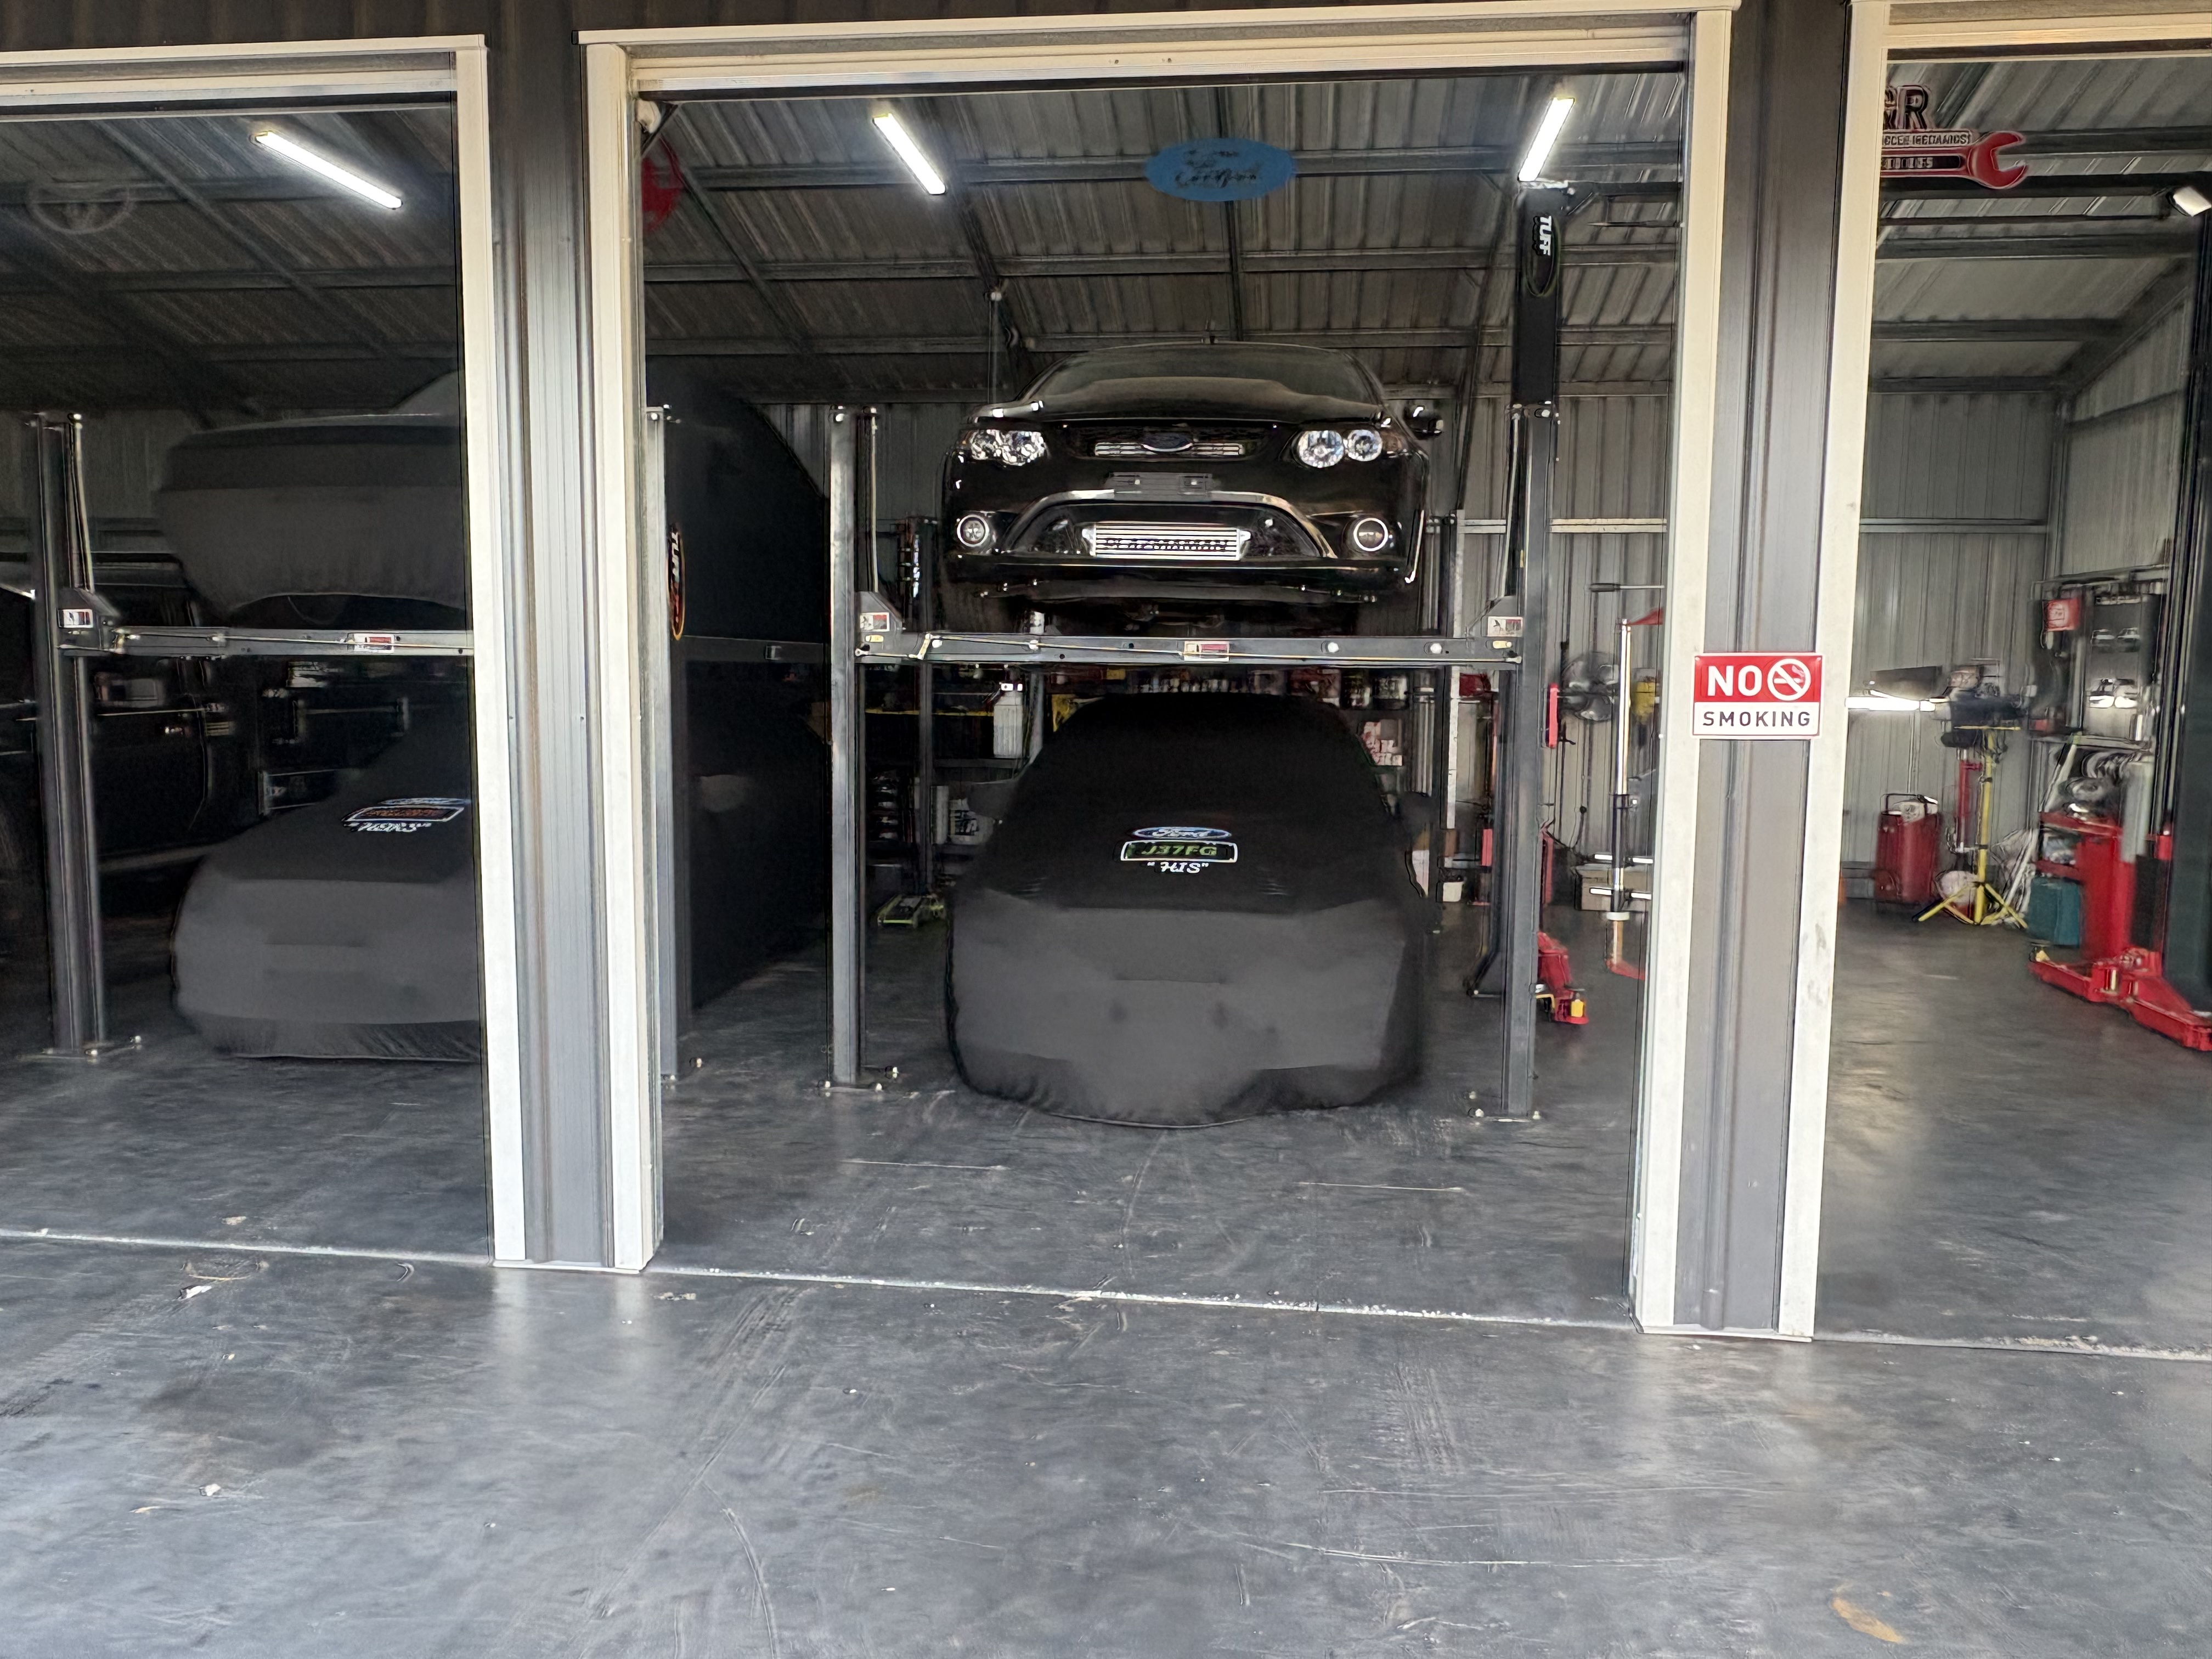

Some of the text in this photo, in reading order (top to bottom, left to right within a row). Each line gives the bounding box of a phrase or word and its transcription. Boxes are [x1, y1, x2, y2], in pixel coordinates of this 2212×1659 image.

[1539, 215, 1552, 256] TUFF
[1707, 664, 1763, 697] NO
[1702, 711, 1810, 727] SMOKING
[1152, 828, 1211, 838] Ford
